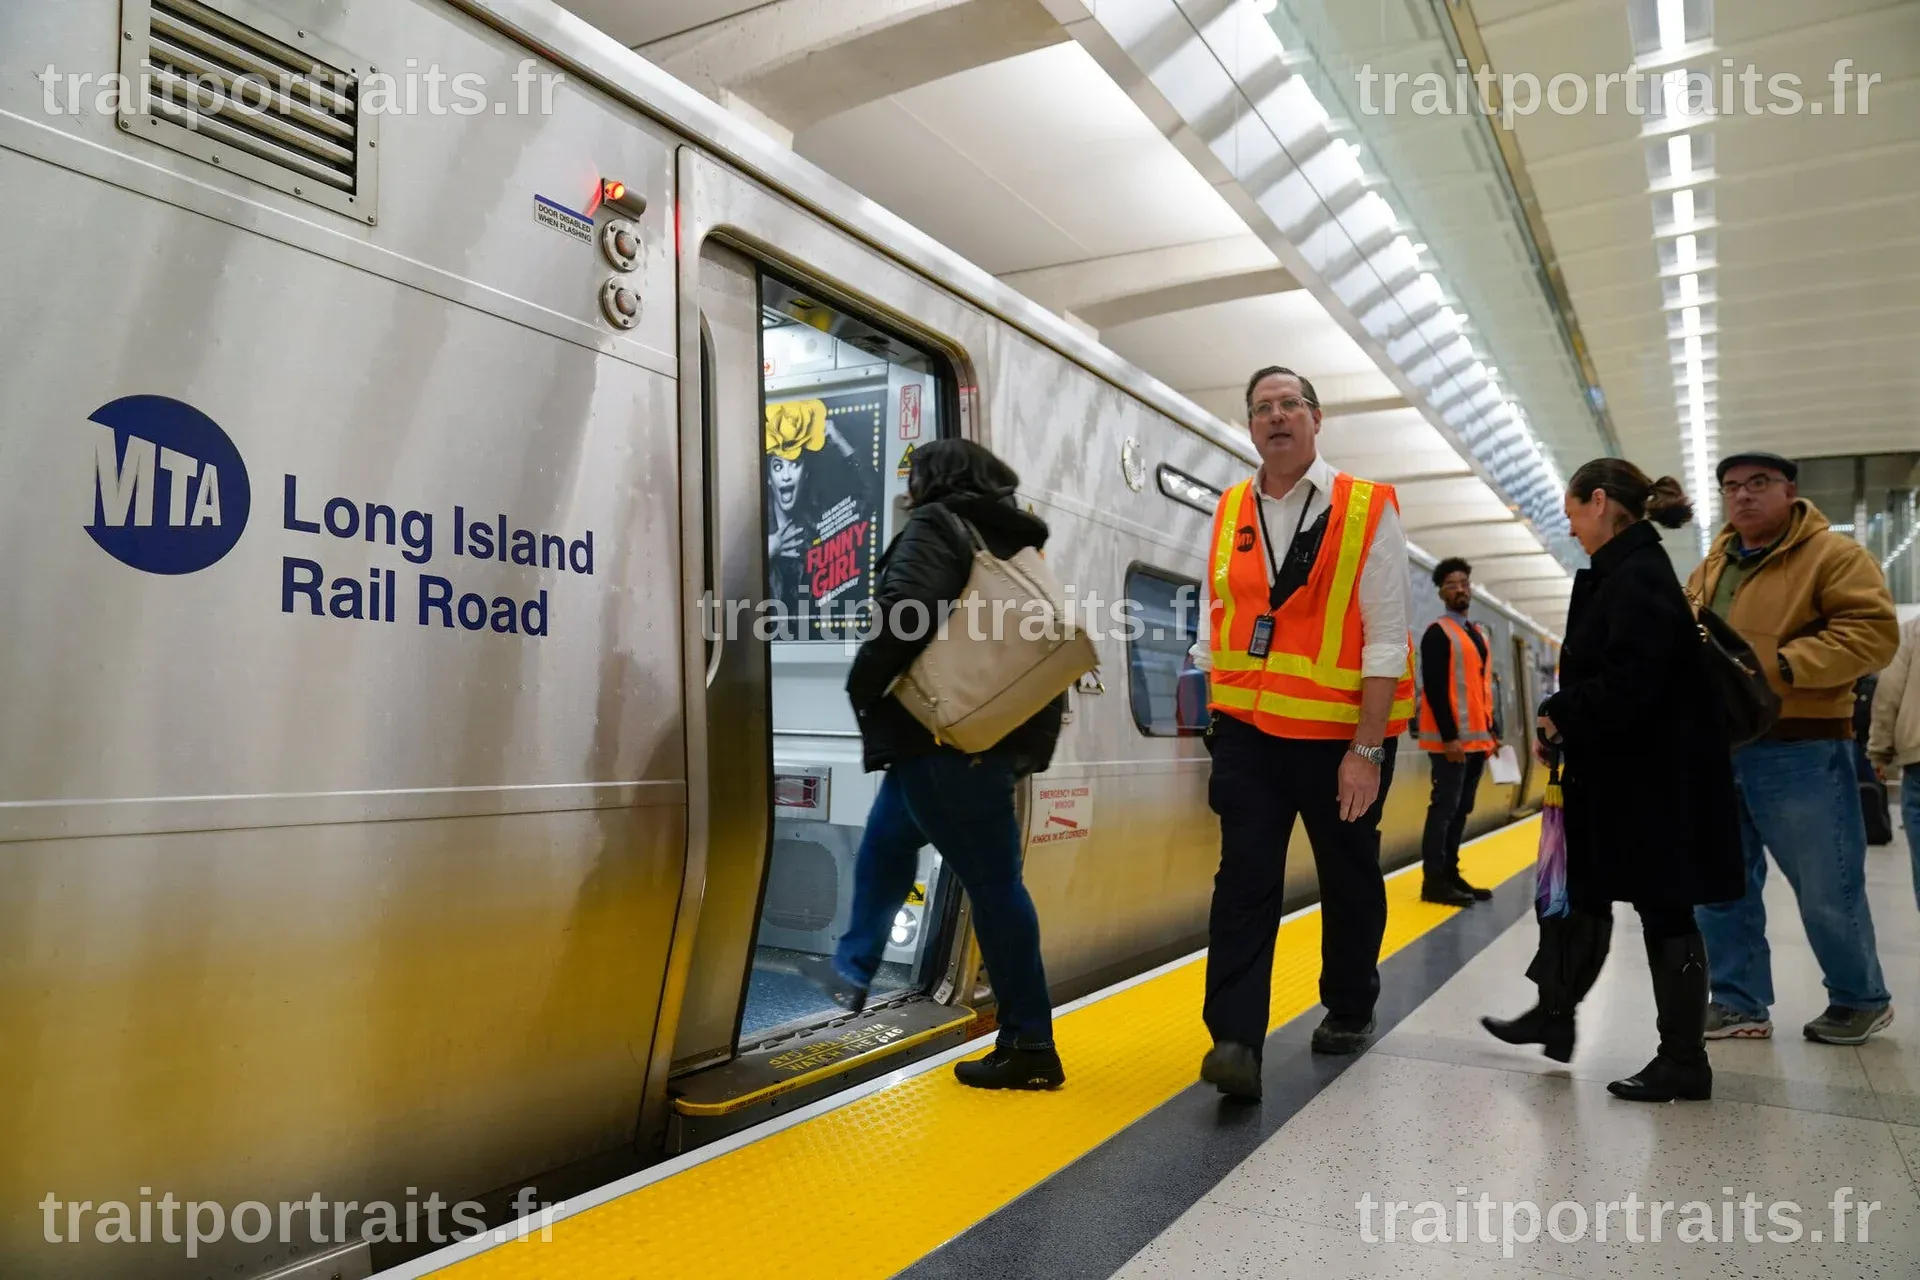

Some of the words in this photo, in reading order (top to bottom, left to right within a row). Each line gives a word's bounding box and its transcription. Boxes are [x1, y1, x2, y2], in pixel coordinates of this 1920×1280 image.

[538, 204, 558, 218] DOOR
[559, 213, 591, 233] DISABLED
[538, 213, 559, 228] WHEN
[560, 223, 592, 243] FLASHING
[902, 387, 912, 437] EXIT
[283, 474, 433, 564] Long
[455, 506, 594, 575] Island
[807, 520, 869, 574] FUNNY
[281, 557, 396, 623] Rail
[419, 574, 548, 637] Road
[812, 549, 862, 598] GIRL
[785, 1050, 846, 1071] WATCH
[844, 1038, 878, 1051] THE
[875, 1028, 905, 1044] GAP
